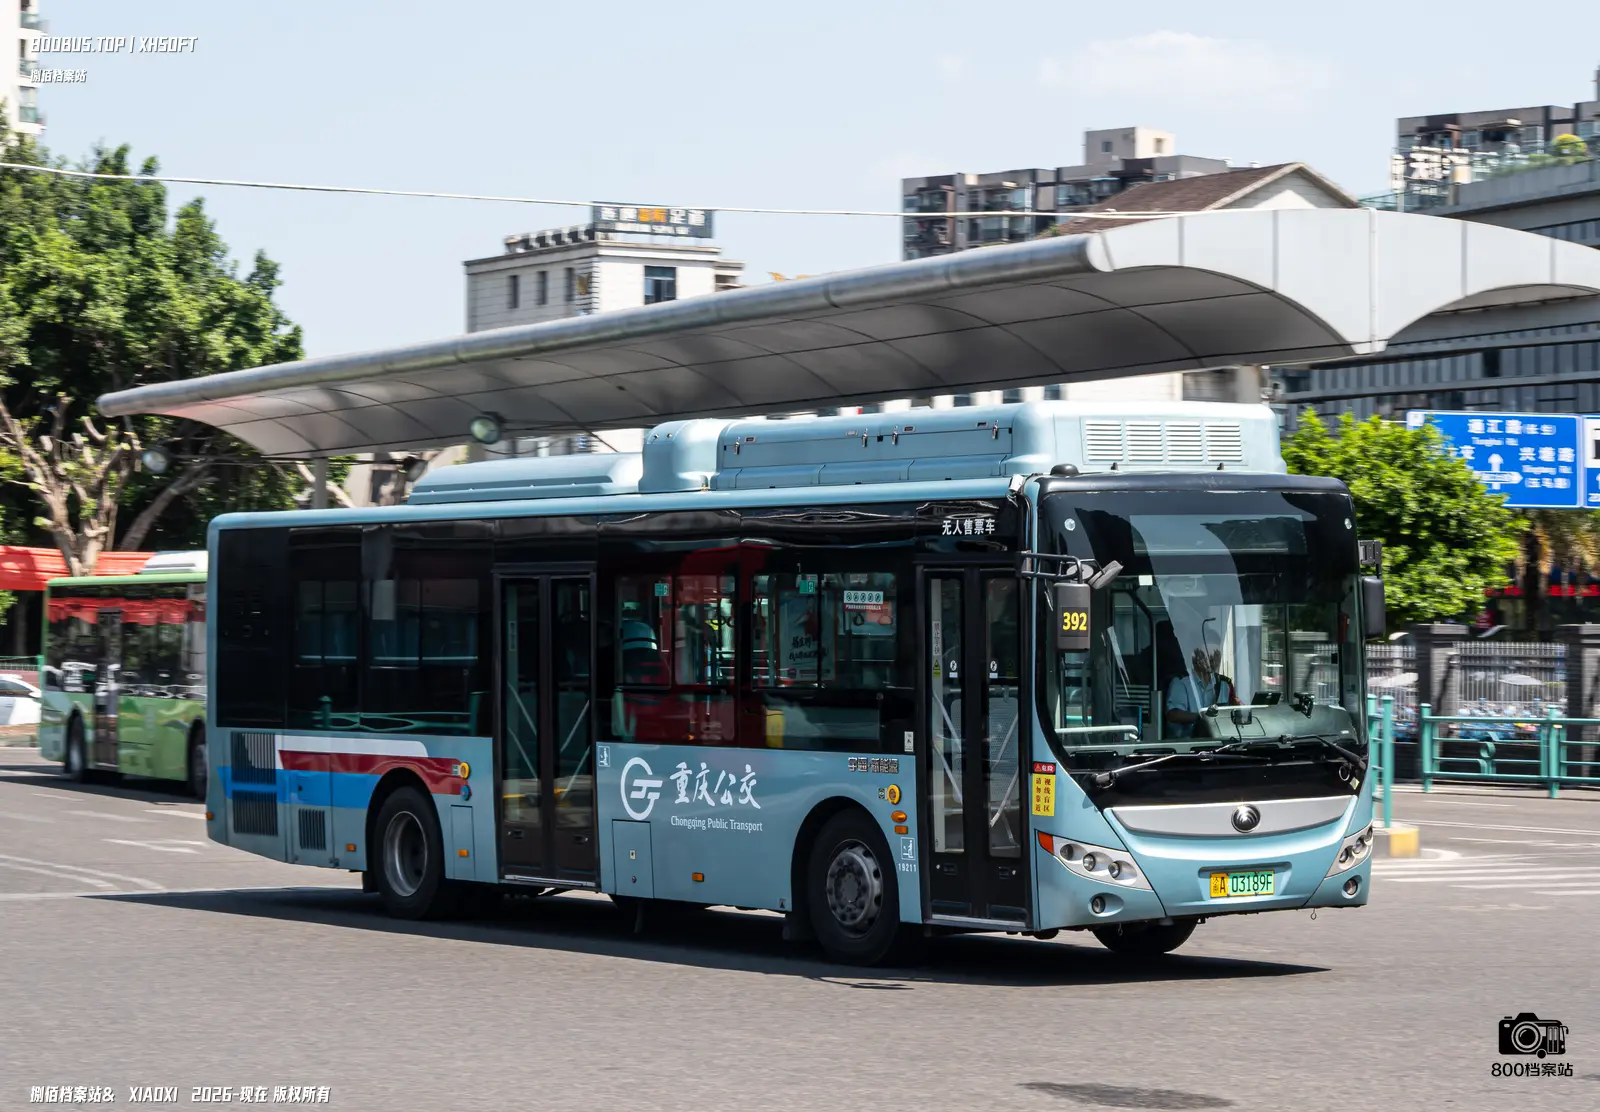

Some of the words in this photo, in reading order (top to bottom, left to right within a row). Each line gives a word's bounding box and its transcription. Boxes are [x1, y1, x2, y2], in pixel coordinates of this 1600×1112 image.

[942, 518, 996, 536] 无人售票车
[1062, 612, 1087, 631] 392
[669, 761, 762, 810] 重庆公交
[670, 815, 707, 831] Chongqing
[707, 818, 728, 829] Public
[729, 819, 763, 833] Transport
[898, 863, 917, 872] 19211
